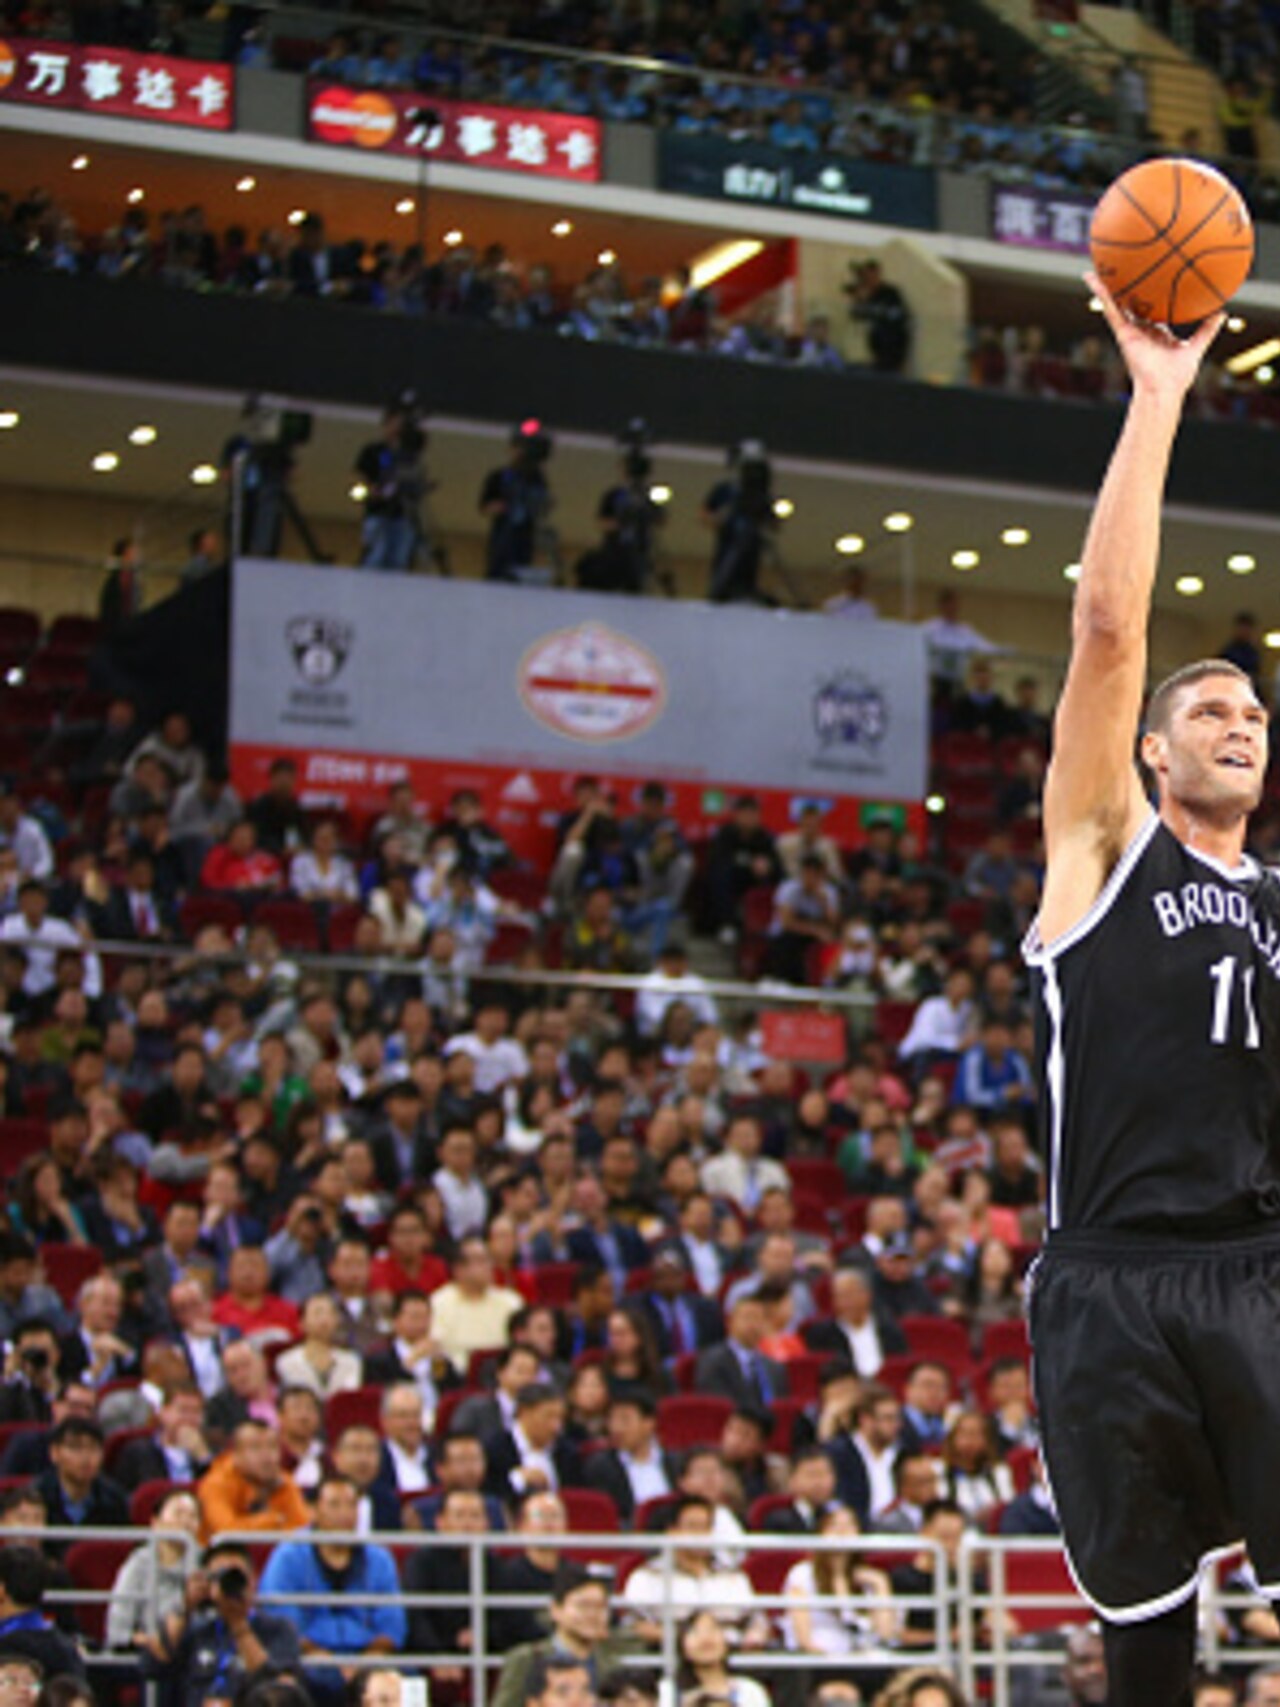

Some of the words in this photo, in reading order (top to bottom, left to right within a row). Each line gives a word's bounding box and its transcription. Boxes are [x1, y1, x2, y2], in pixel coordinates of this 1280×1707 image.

[27, 52, 229, 117] 万事达卡
[1210, 955, 1260, 1049] 11
